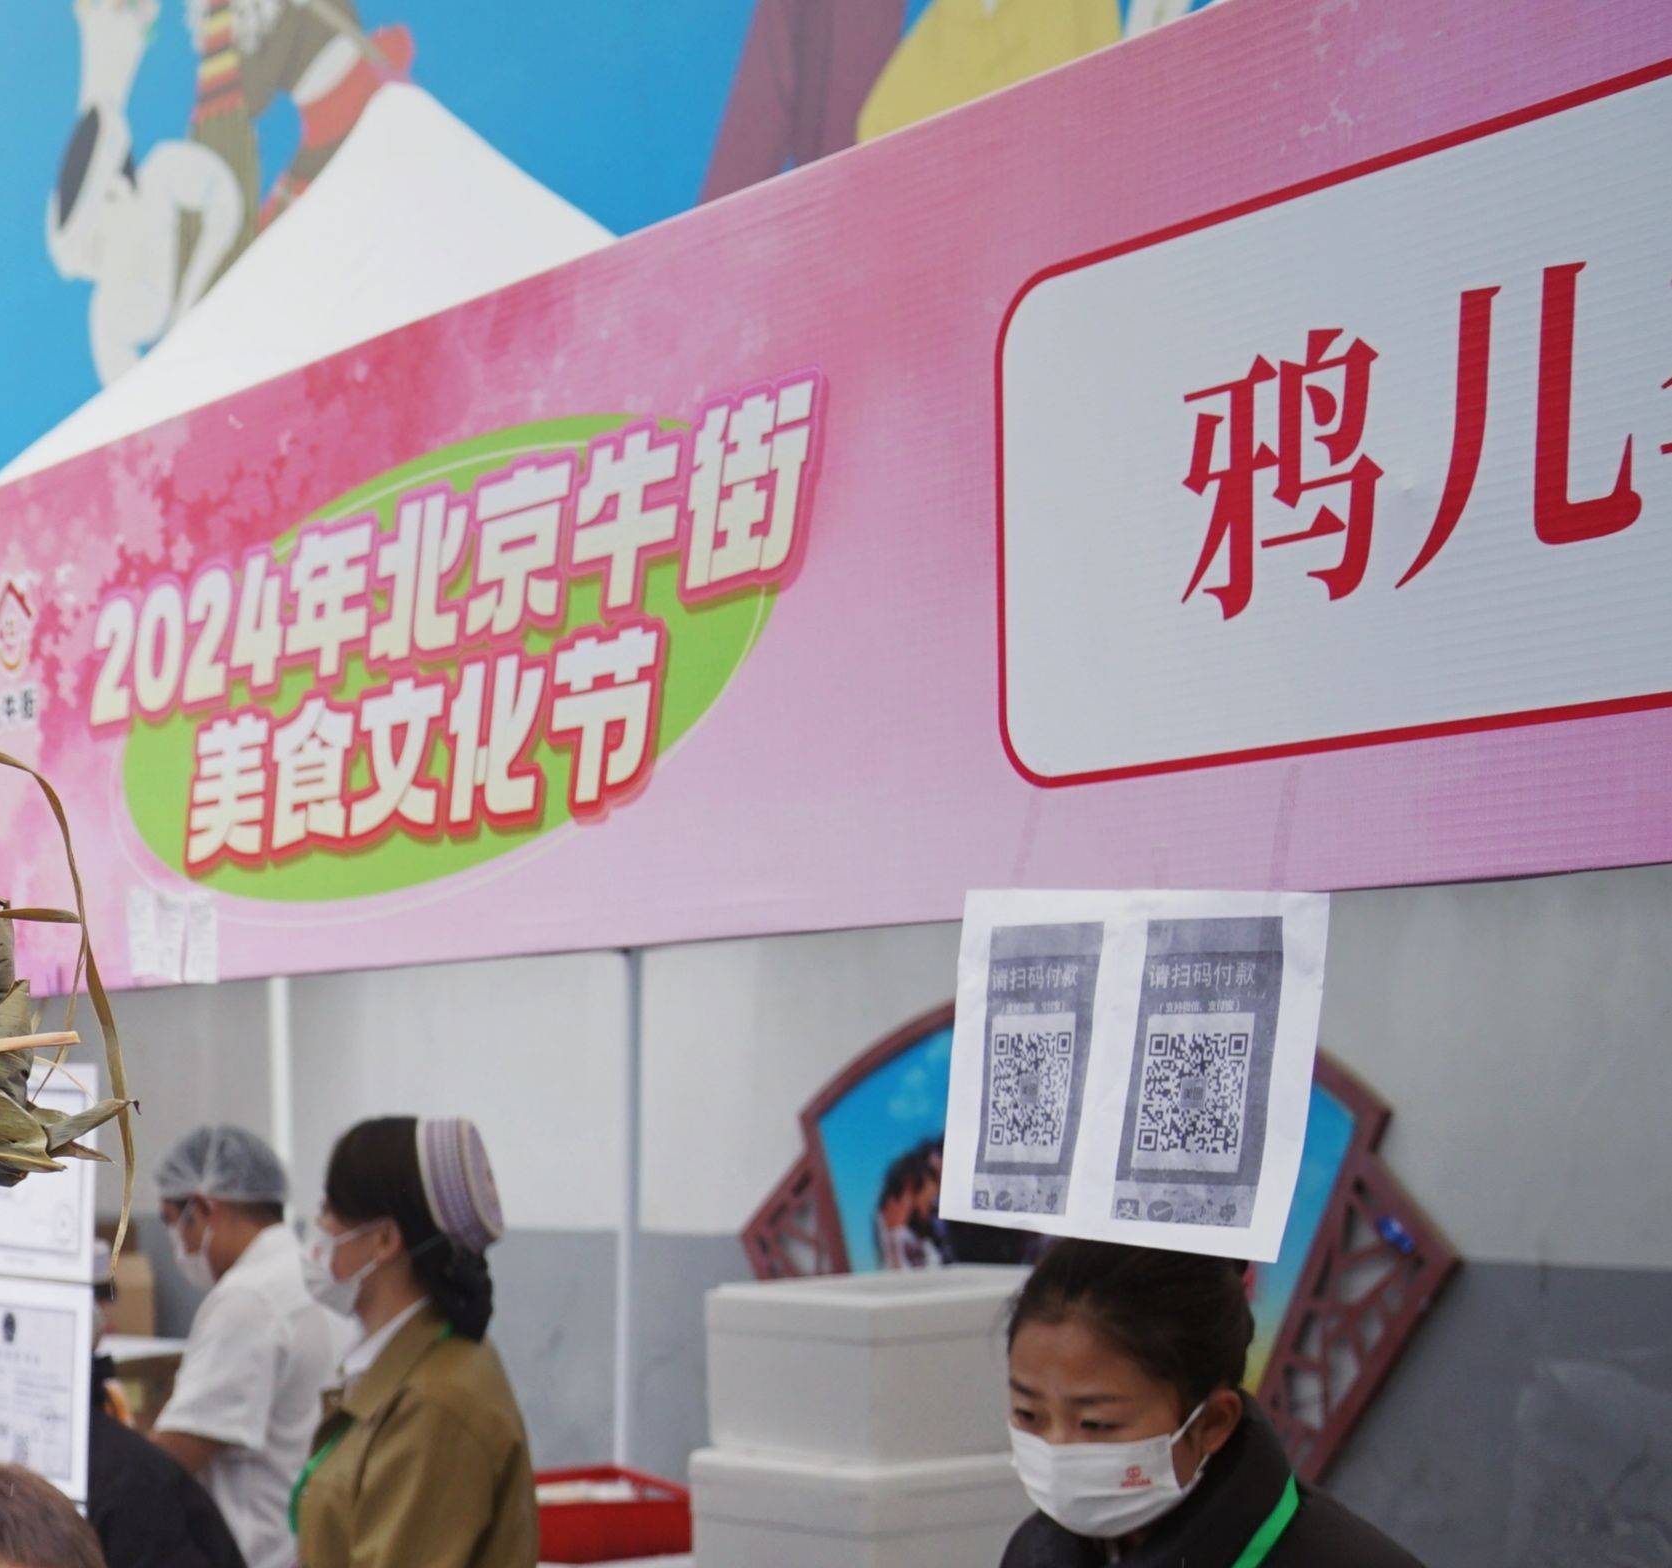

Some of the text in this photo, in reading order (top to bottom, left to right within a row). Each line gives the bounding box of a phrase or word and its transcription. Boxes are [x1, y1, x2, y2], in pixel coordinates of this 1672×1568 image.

[91, 380, 816, 724] 2024年北京牛街
[1182, 261, 1672, 621] 鸦儿
[187, 625, 661, 866] 美食文化节
[991, 964, 1079, 991] 请扫码付款
[1149, 961, 1256, 989] 请扫码付款
